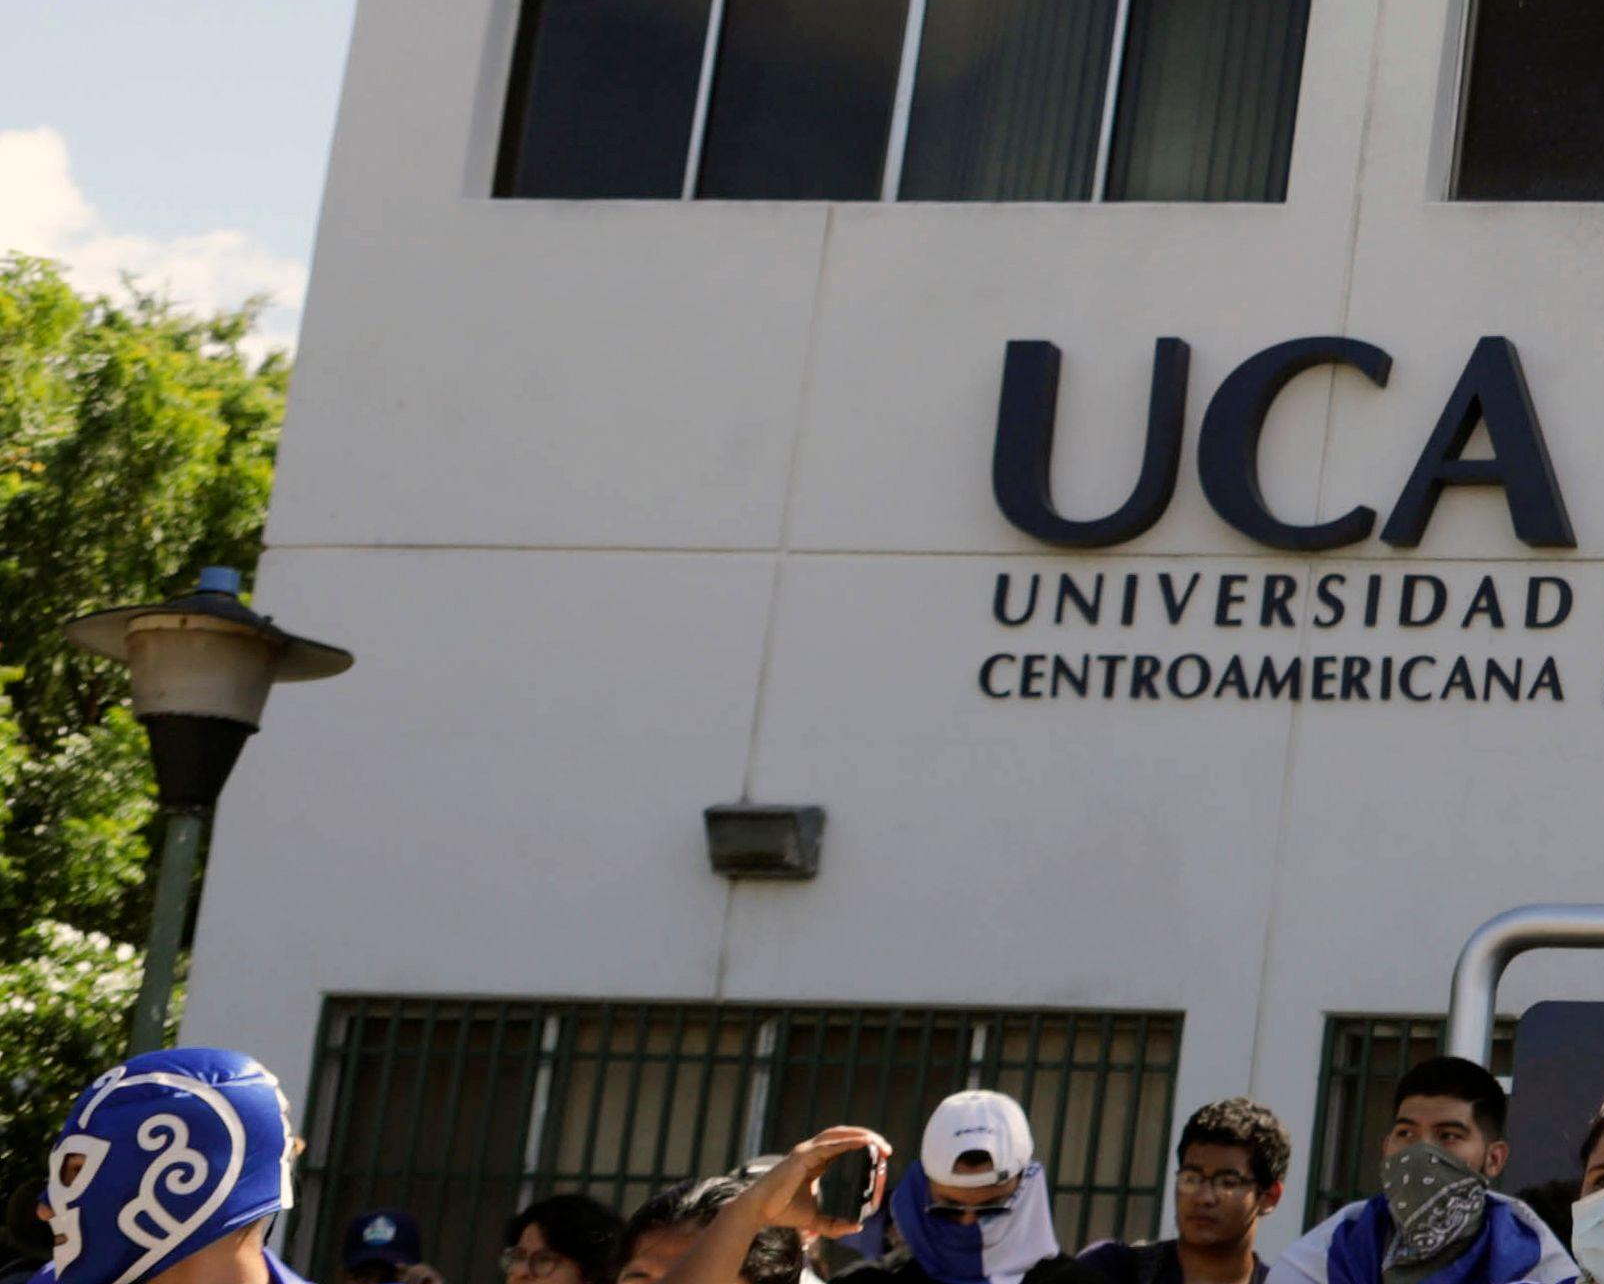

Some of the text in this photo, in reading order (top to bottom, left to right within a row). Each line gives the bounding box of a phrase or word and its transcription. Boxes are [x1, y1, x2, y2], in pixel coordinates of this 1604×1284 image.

[991, 335, 1579, 553] UCA
[992, 572, 1576, 631] UNIVERSIDAD
[978, 652, 1566, 704] CENTROAMERICANA
